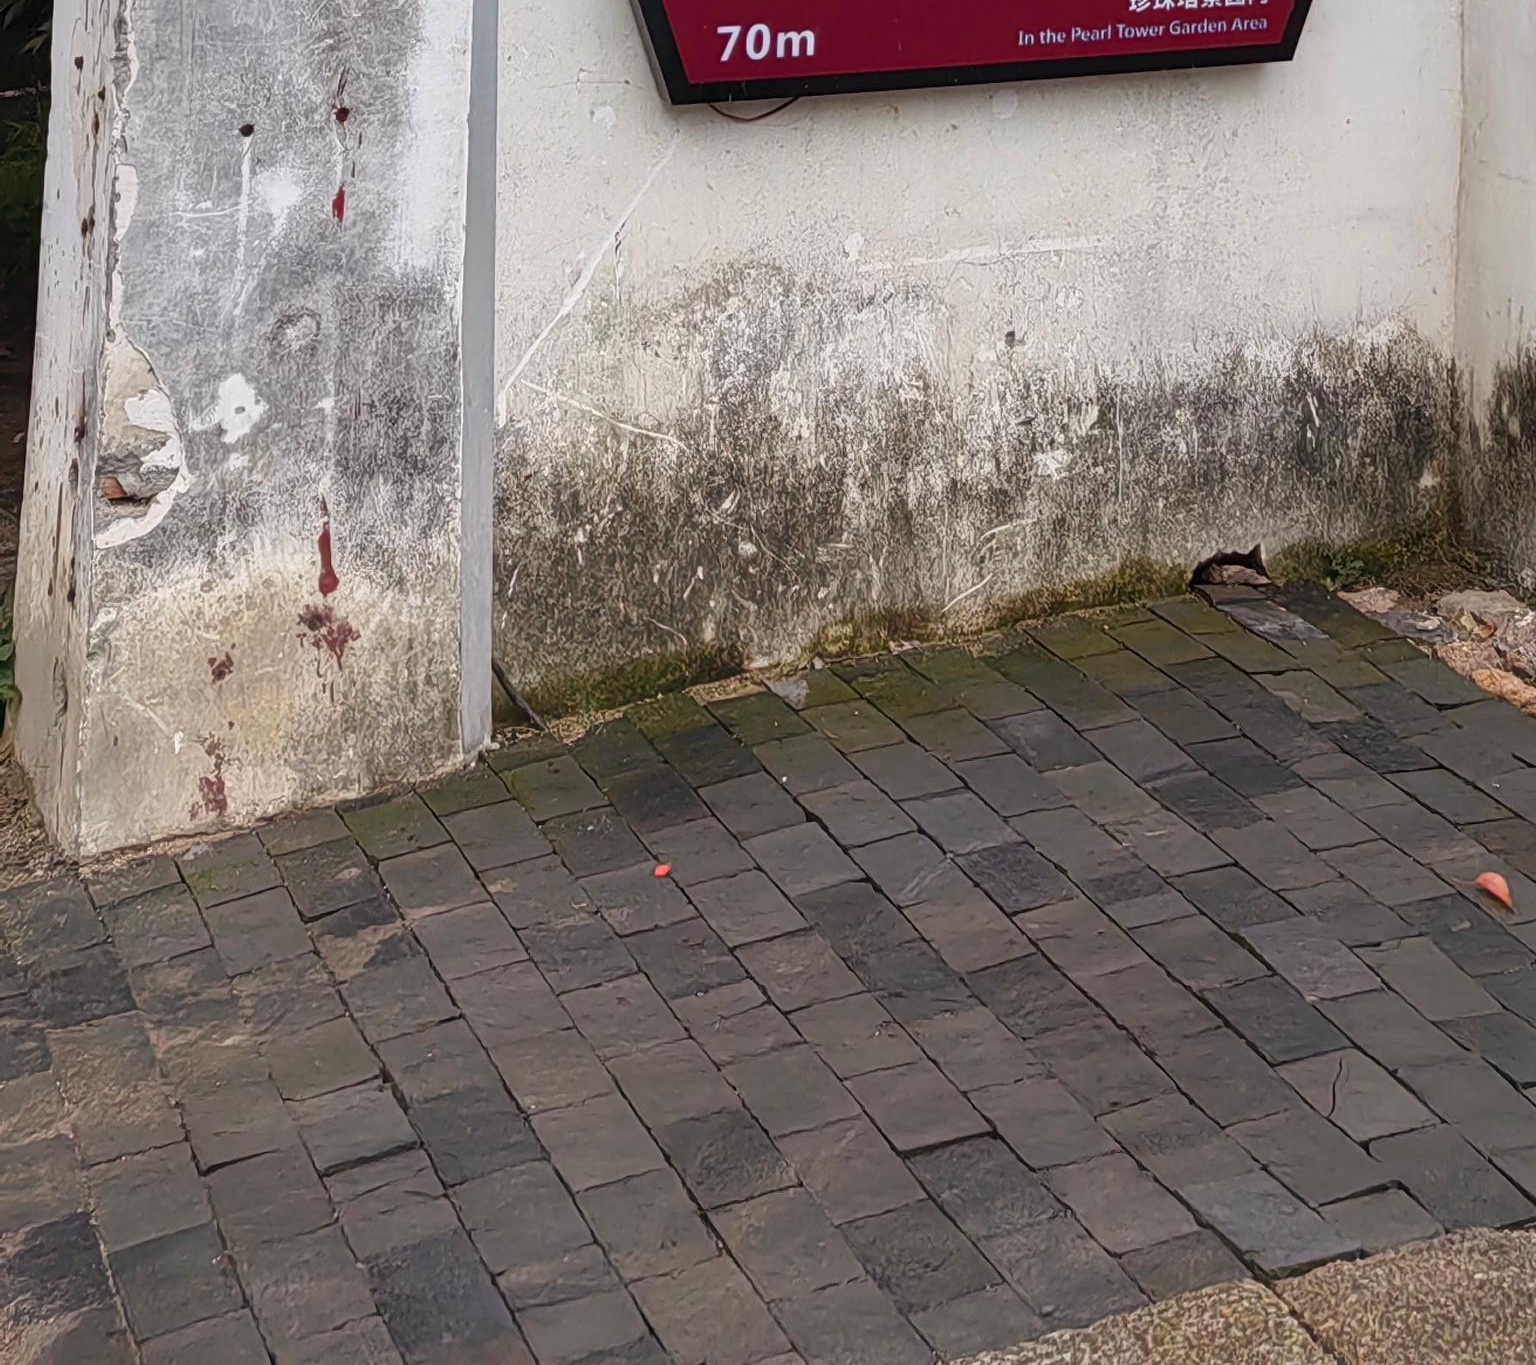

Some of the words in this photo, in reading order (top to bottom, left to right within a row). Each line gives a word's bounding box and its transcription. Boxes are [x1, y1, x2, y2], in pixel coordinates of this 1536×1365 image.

[717, 23, 816, 62] 70m
[1018, 29, 1034, 46] In
[1040, 28, 1066, 44] the
[1071, 24, 1112, 42] Pearl
[1116, 22, 1165, 40] Tower
[1169, 18, 1227, 35] Garden
[1231, 17, 1268, 31] Area
